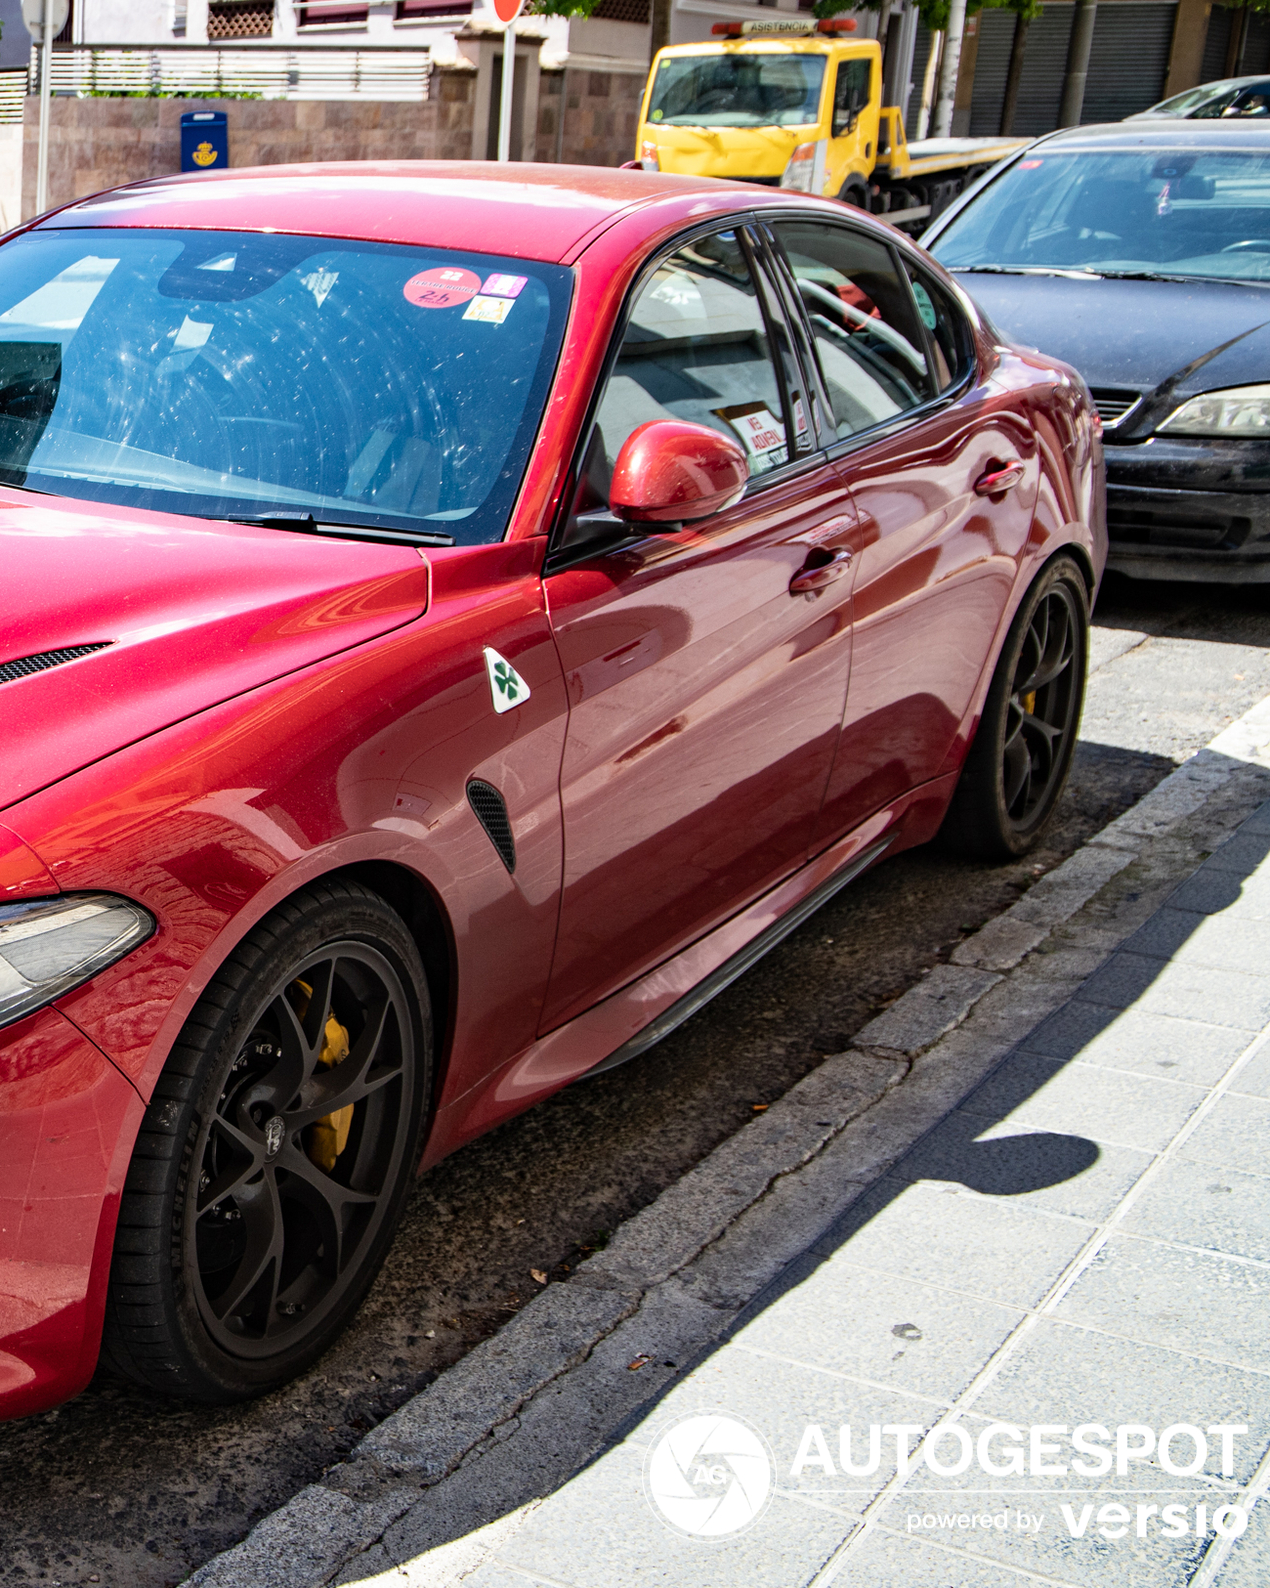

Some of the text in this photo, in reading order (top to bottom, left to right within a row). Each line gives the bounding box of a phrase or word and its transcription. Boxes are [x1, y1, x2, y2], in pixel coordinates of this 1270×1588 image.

[751, 21, 809, 32] ASISTENCIA
[440, 270, 464, 281] 22
[411, 279, 477, 294] TERTRE ROUGE
[171, 1120, 199, 1269] MICHELIN
